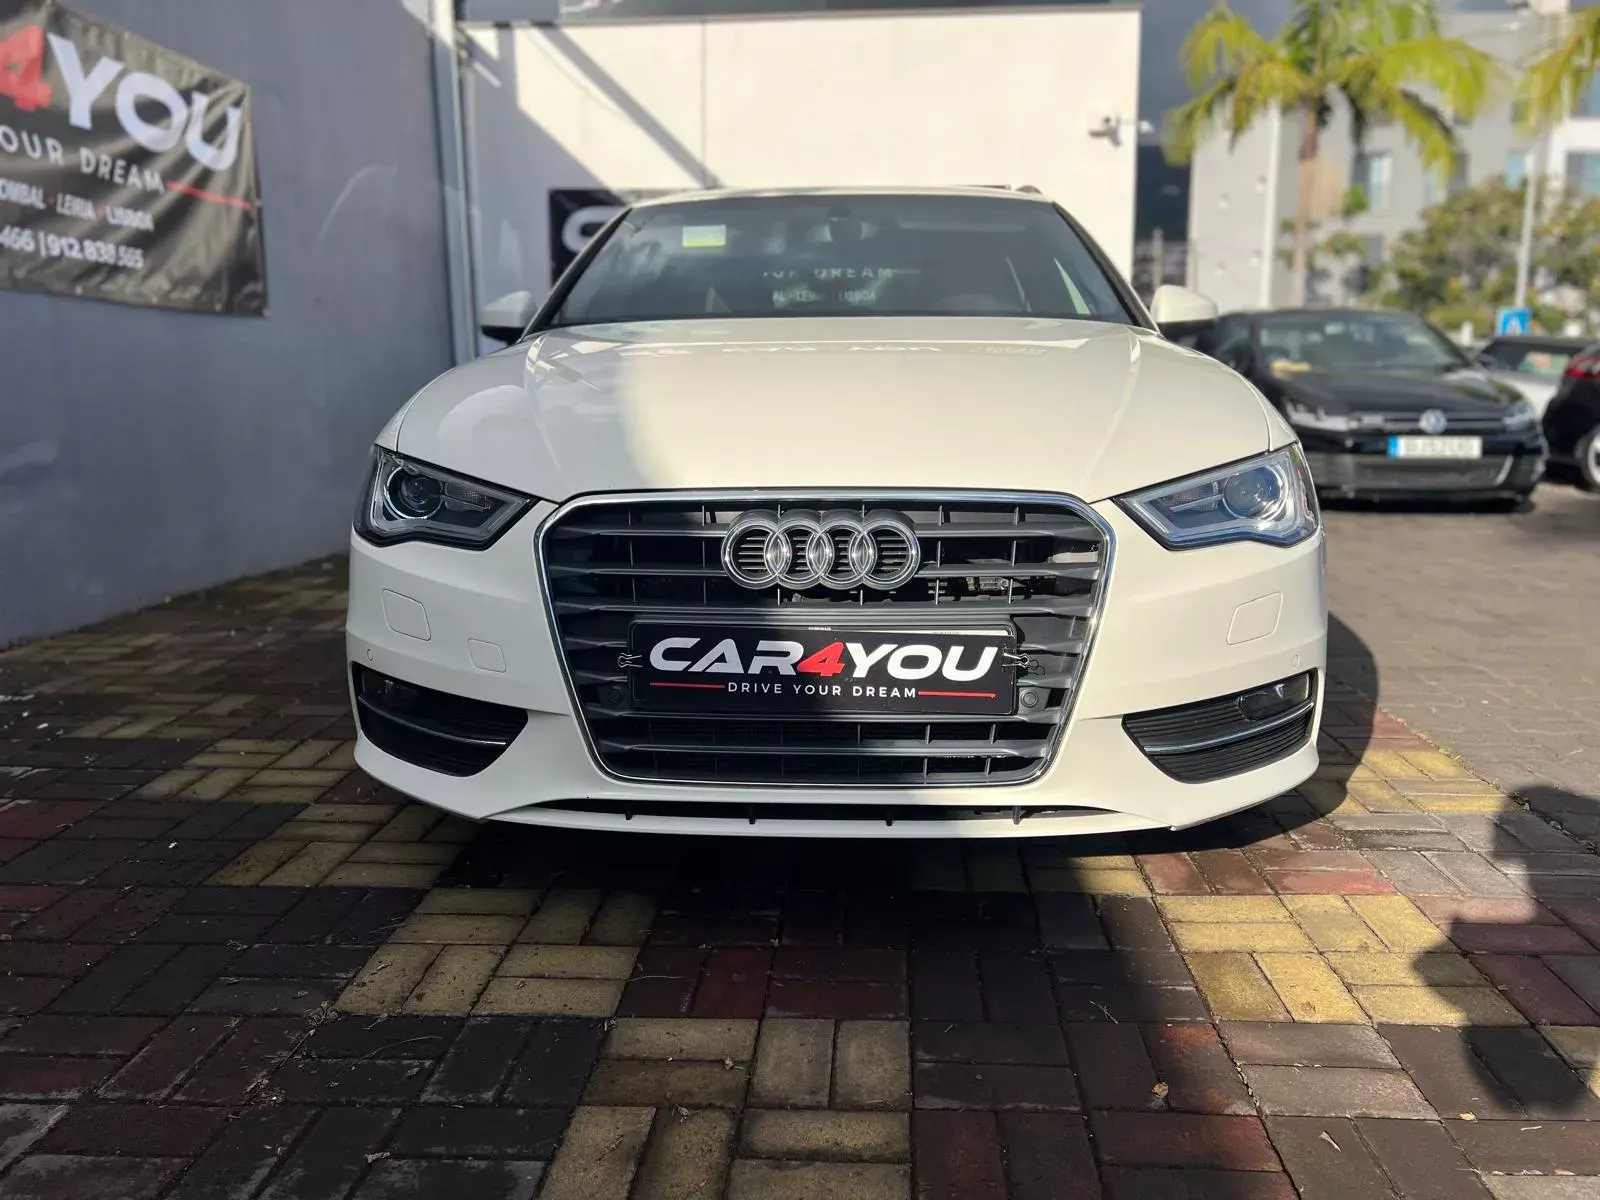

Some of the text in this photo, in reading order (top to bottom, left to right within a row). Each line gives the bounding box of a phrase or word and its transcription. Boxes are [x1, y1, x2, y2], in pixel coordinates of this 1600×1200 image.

[79, 146, 165, 194] DREAM
[649, 637, 998, 682] CAR4YOU
[727, 682, 916, 698] DRIVE YOUR DREAM
